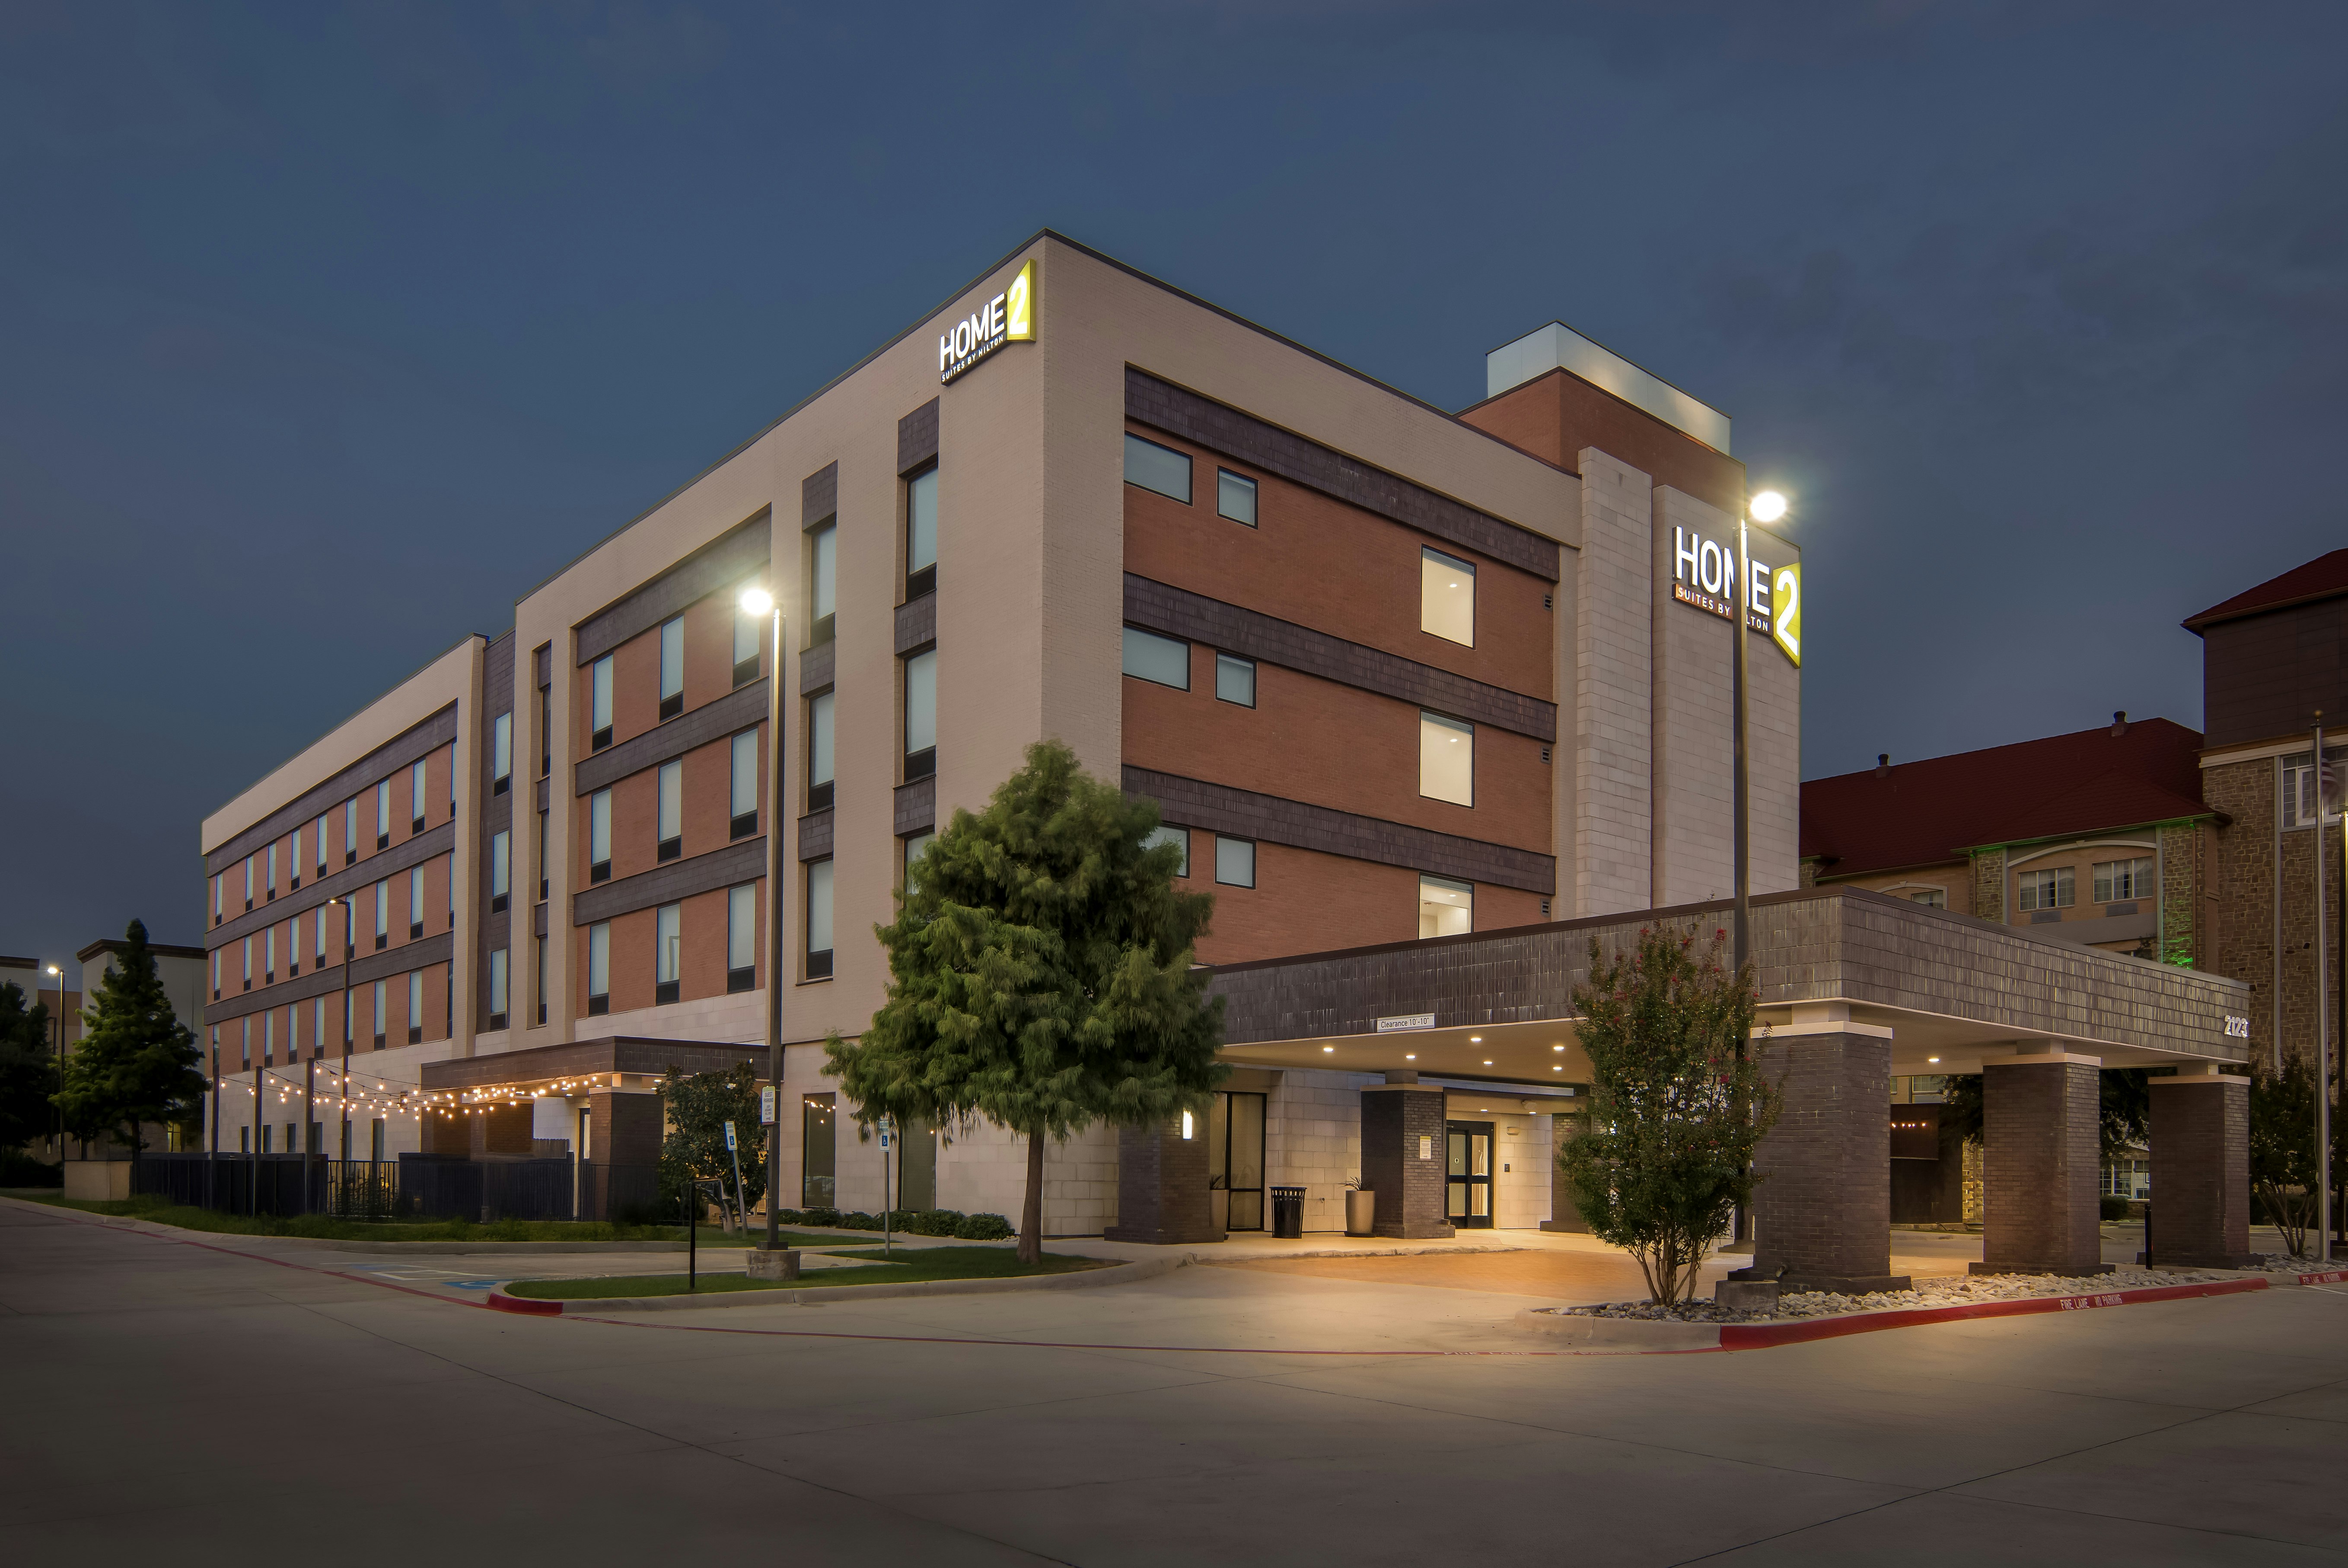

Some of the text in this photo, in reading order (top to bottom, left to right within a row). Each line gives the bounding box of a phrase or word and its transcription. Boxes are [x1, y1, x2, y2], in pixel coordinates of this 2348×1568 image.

[942, 334, 1003, 382] SUITES BY HILTON
[1678, 587, 1714, 610] SUITES
[1718, 604, 1730, 616] BY
[2224, 1015, 2248, 1038] 2123
[2060, 1294, 2122, 1310] FIRE LANE NO PARKING
